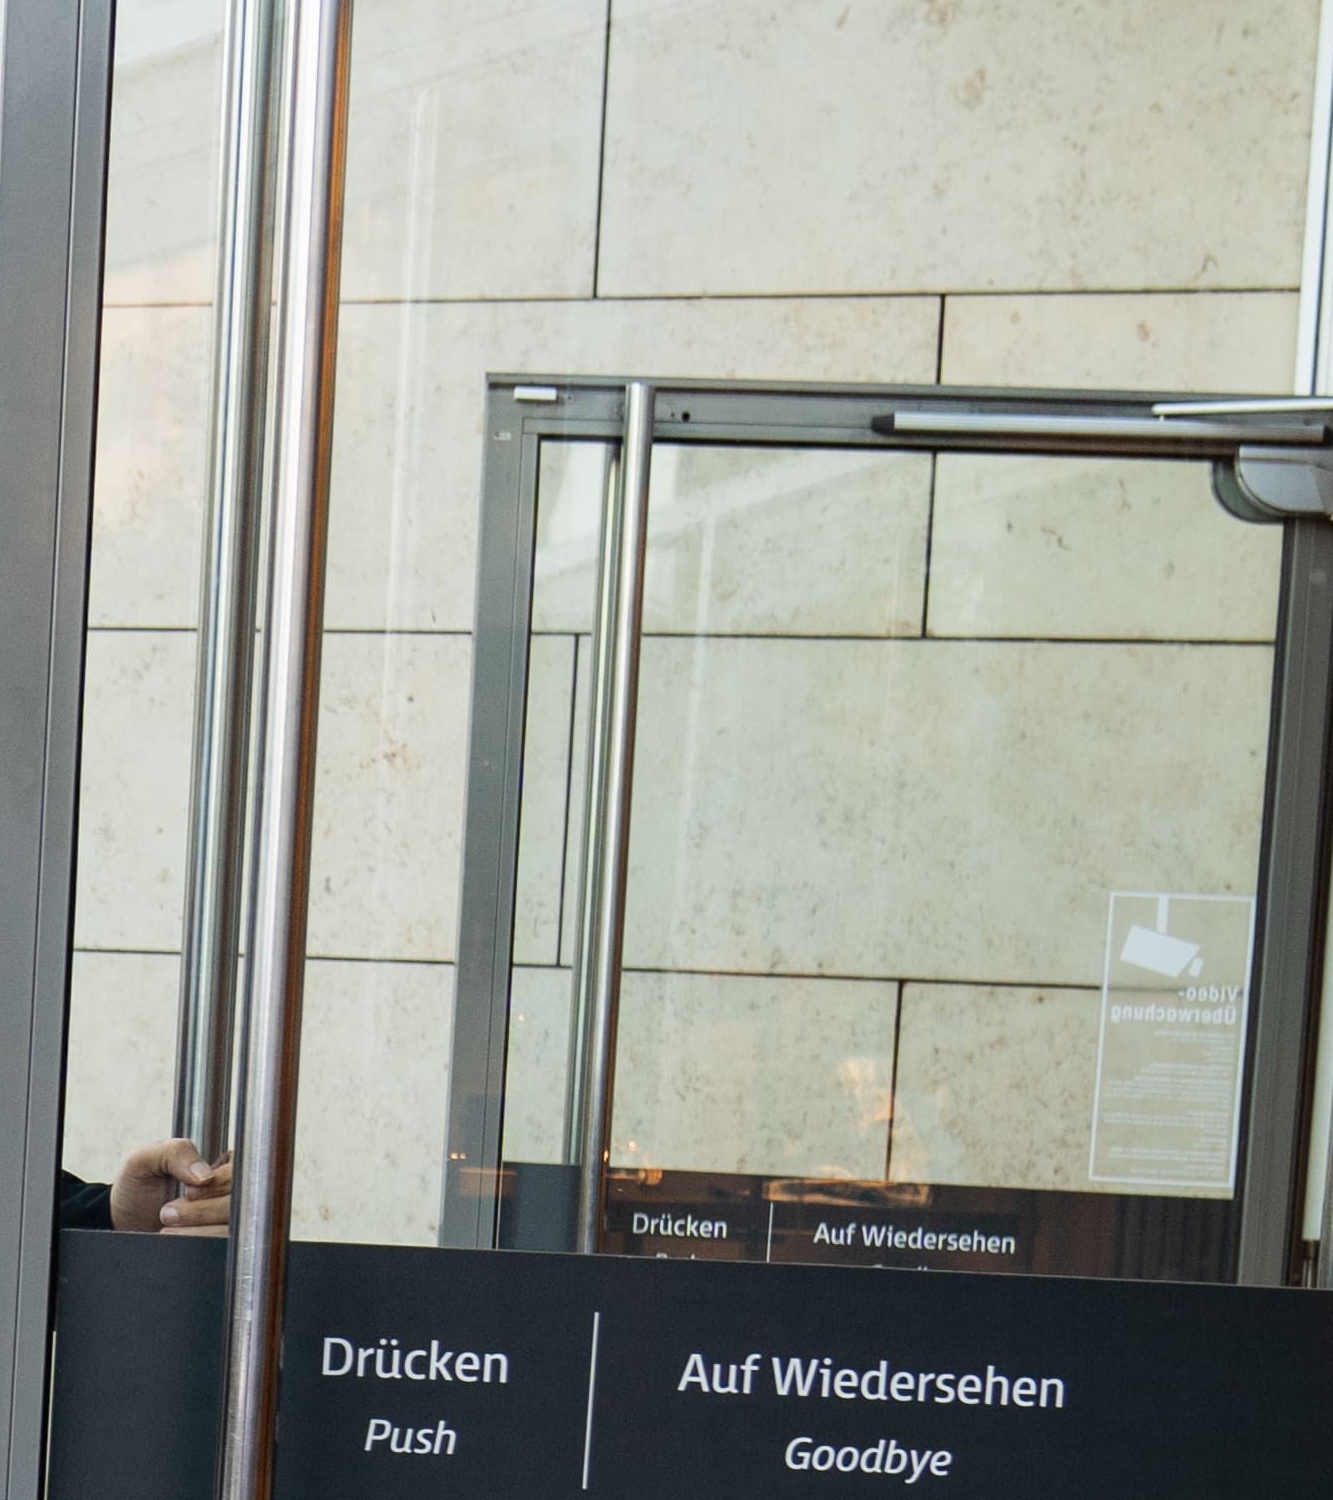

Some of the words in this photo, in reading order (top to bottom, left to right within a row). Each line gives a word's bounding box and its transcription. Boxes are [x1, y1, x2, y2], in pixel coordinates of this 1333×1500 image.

[632, 1212, 727, 1239] Drücken
[813, 1221, 856, 1246] Auf
[861, 1224, 1015, 1254] Wiedersehen
[321, 1336, 508, 1384] Drücken
[677, 1353, 761, 1395] Auf
[771, 1356, 1065, 1409] Wiedersehen
[364, 1418, 457, 1456] Push
[785, 1436, 953, 1485] Goodbye
